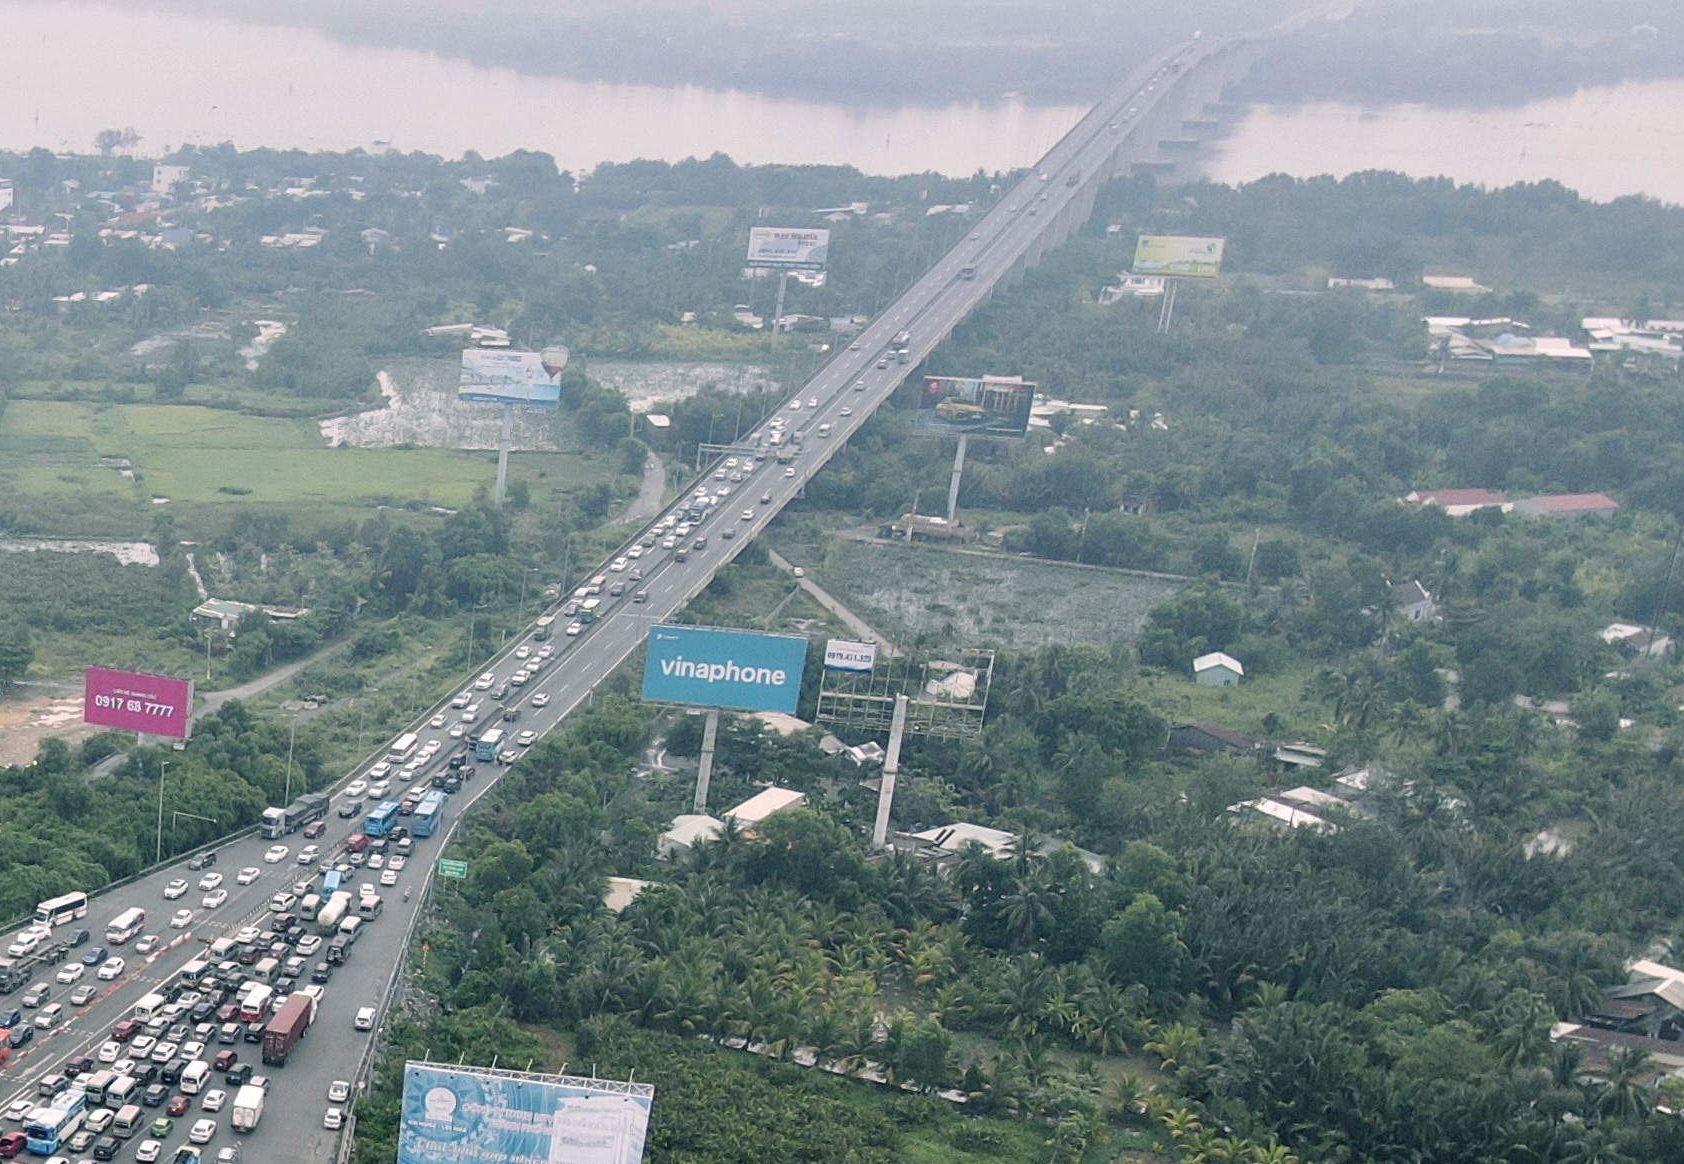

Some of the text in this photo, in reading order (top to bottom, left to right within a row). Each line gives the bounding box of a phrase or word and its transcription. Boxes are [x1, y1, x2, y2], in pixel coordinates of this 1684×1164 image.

[661, 656, 786, 685] vinaphone
[95, 695, 124, 710] 0917
[145, 702, 174, 718] 7777
